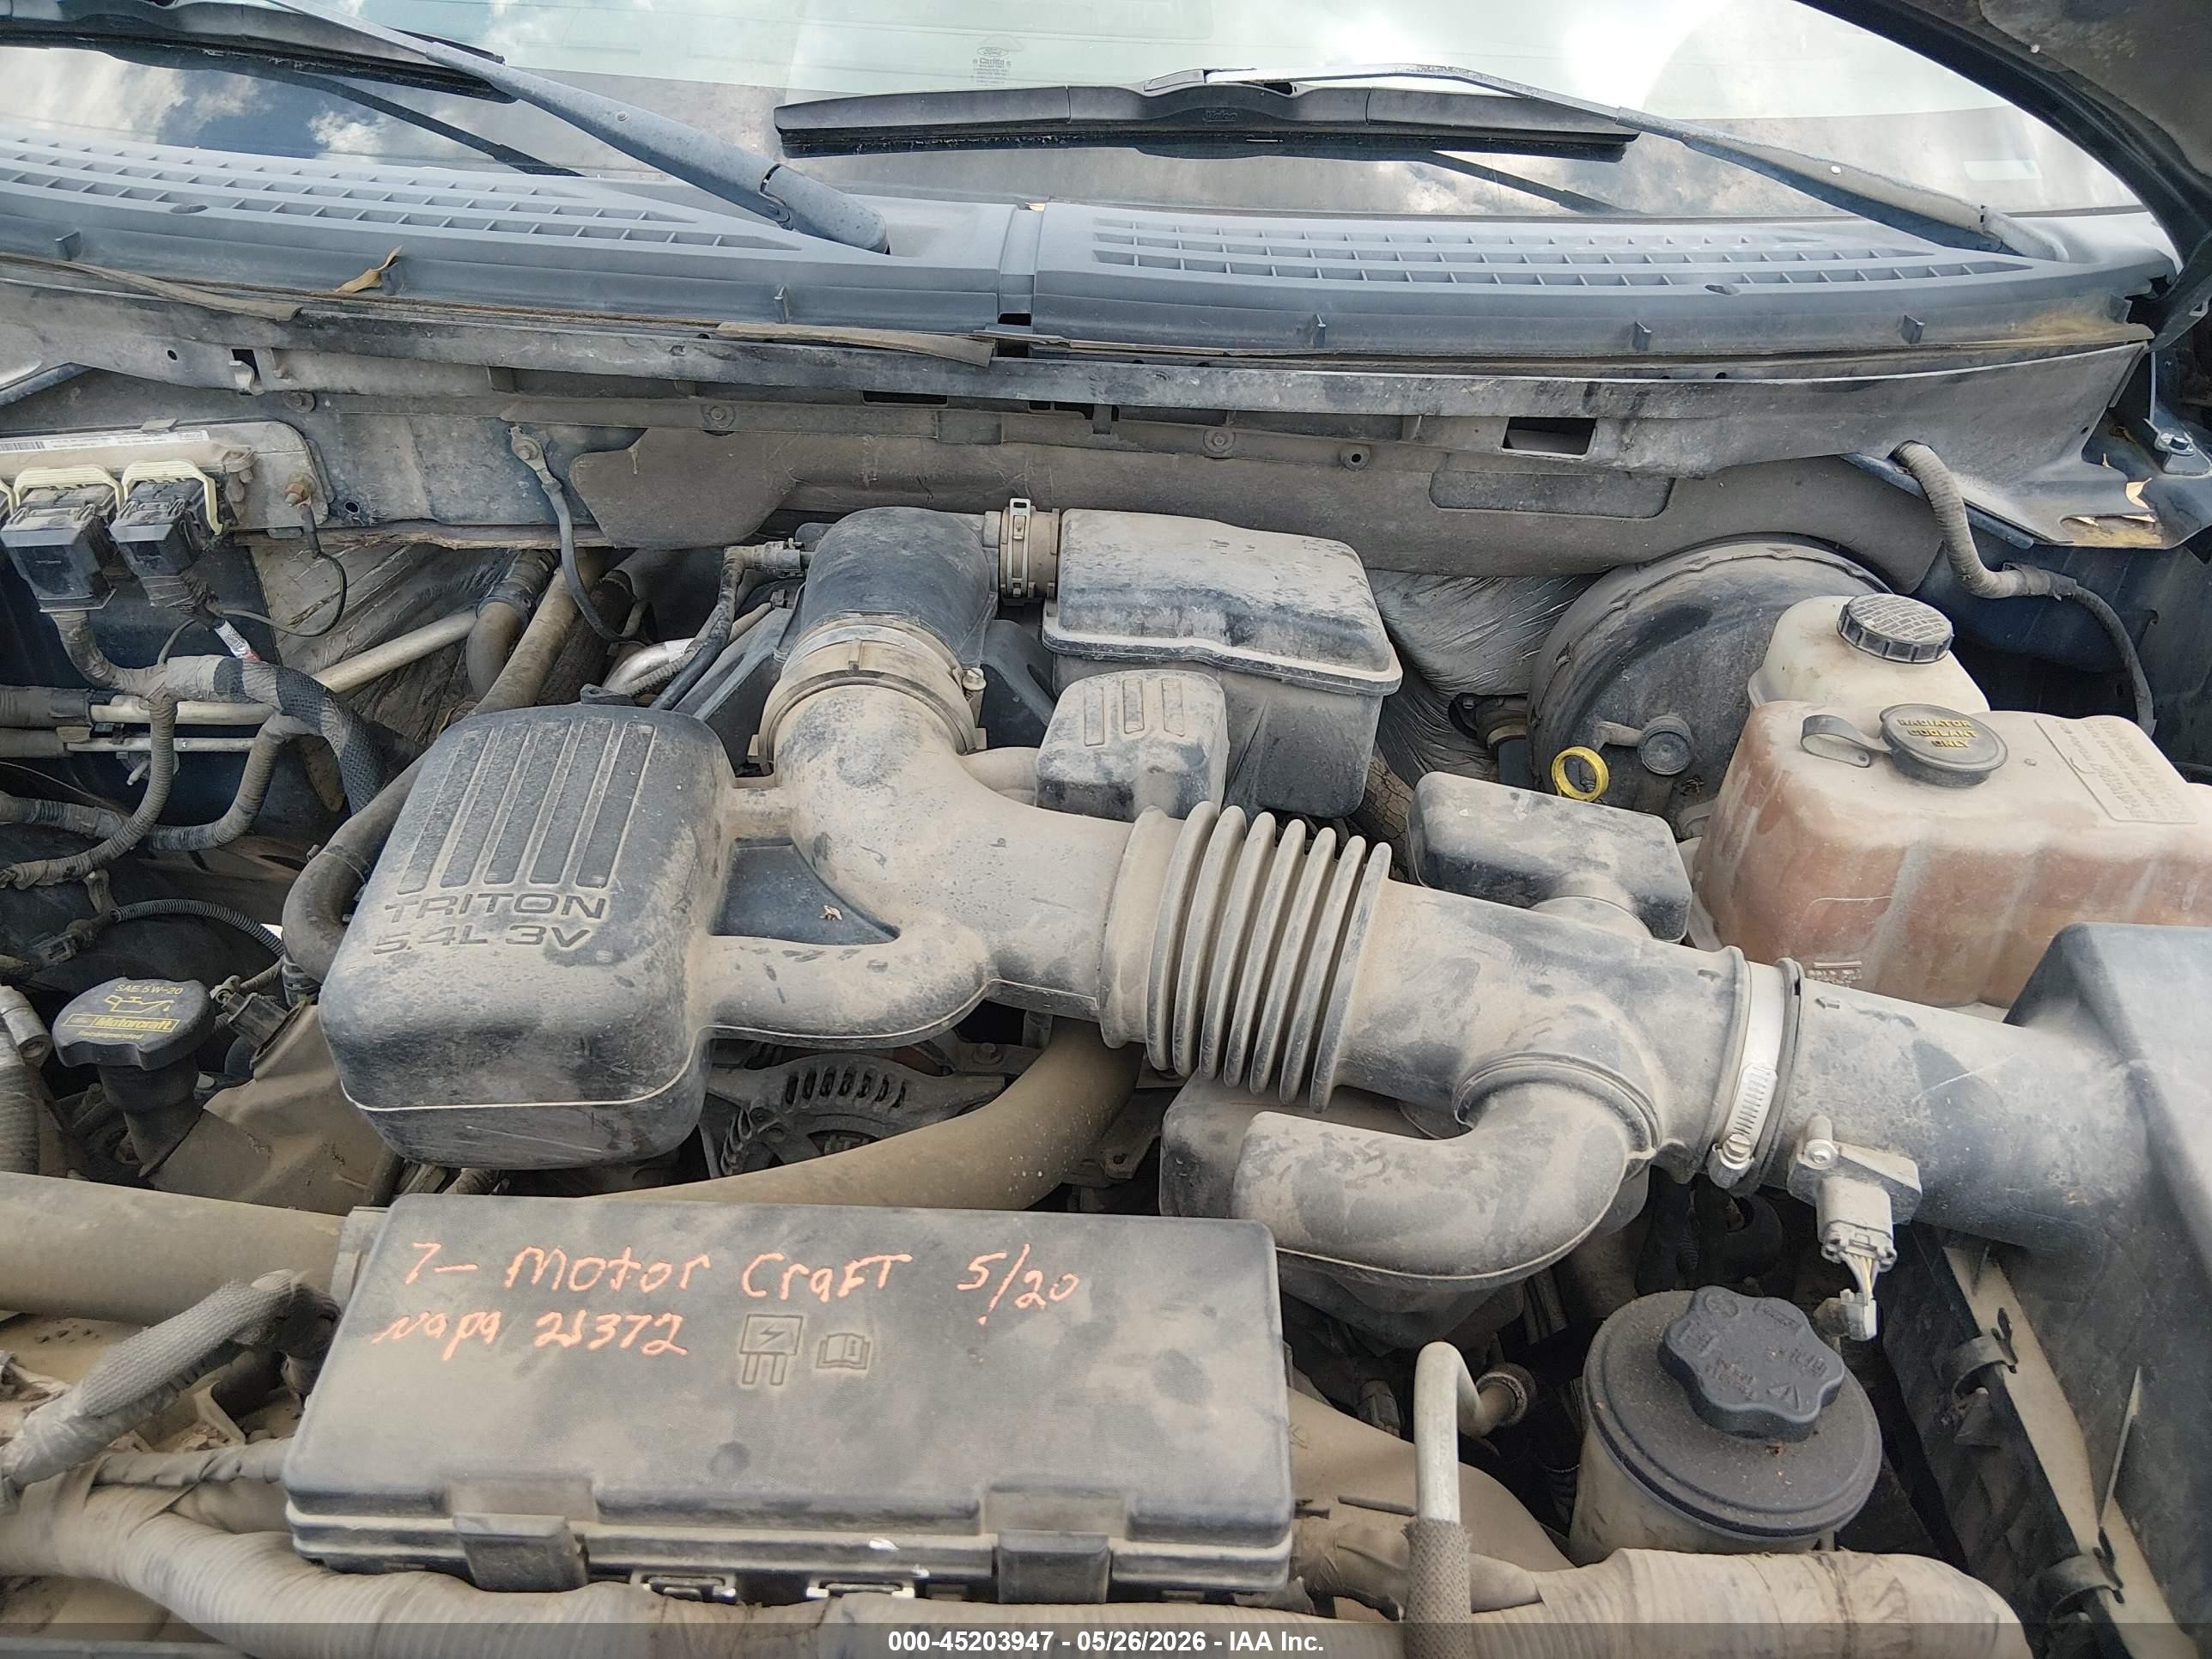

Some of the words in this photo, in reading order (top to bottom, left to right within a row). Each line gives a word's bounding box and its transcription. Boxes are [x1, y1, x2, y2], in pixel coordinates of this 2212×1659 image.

[1897, 719, 1972, 727] RADIATOR
[1907, 729, 1978, 738] COOLANT
[384, 893, 606, 923] TRITON
[373, 925, 488, 955] 5.4L
[505, 925, 591, 948] 3V
[115, 984, 140, 993] SAE
[141, 985, 185, 995] 5W-20
[95, 1017, 172, 1030] Motorcraft
[957, 1243, 1080, 1319] 5/20
